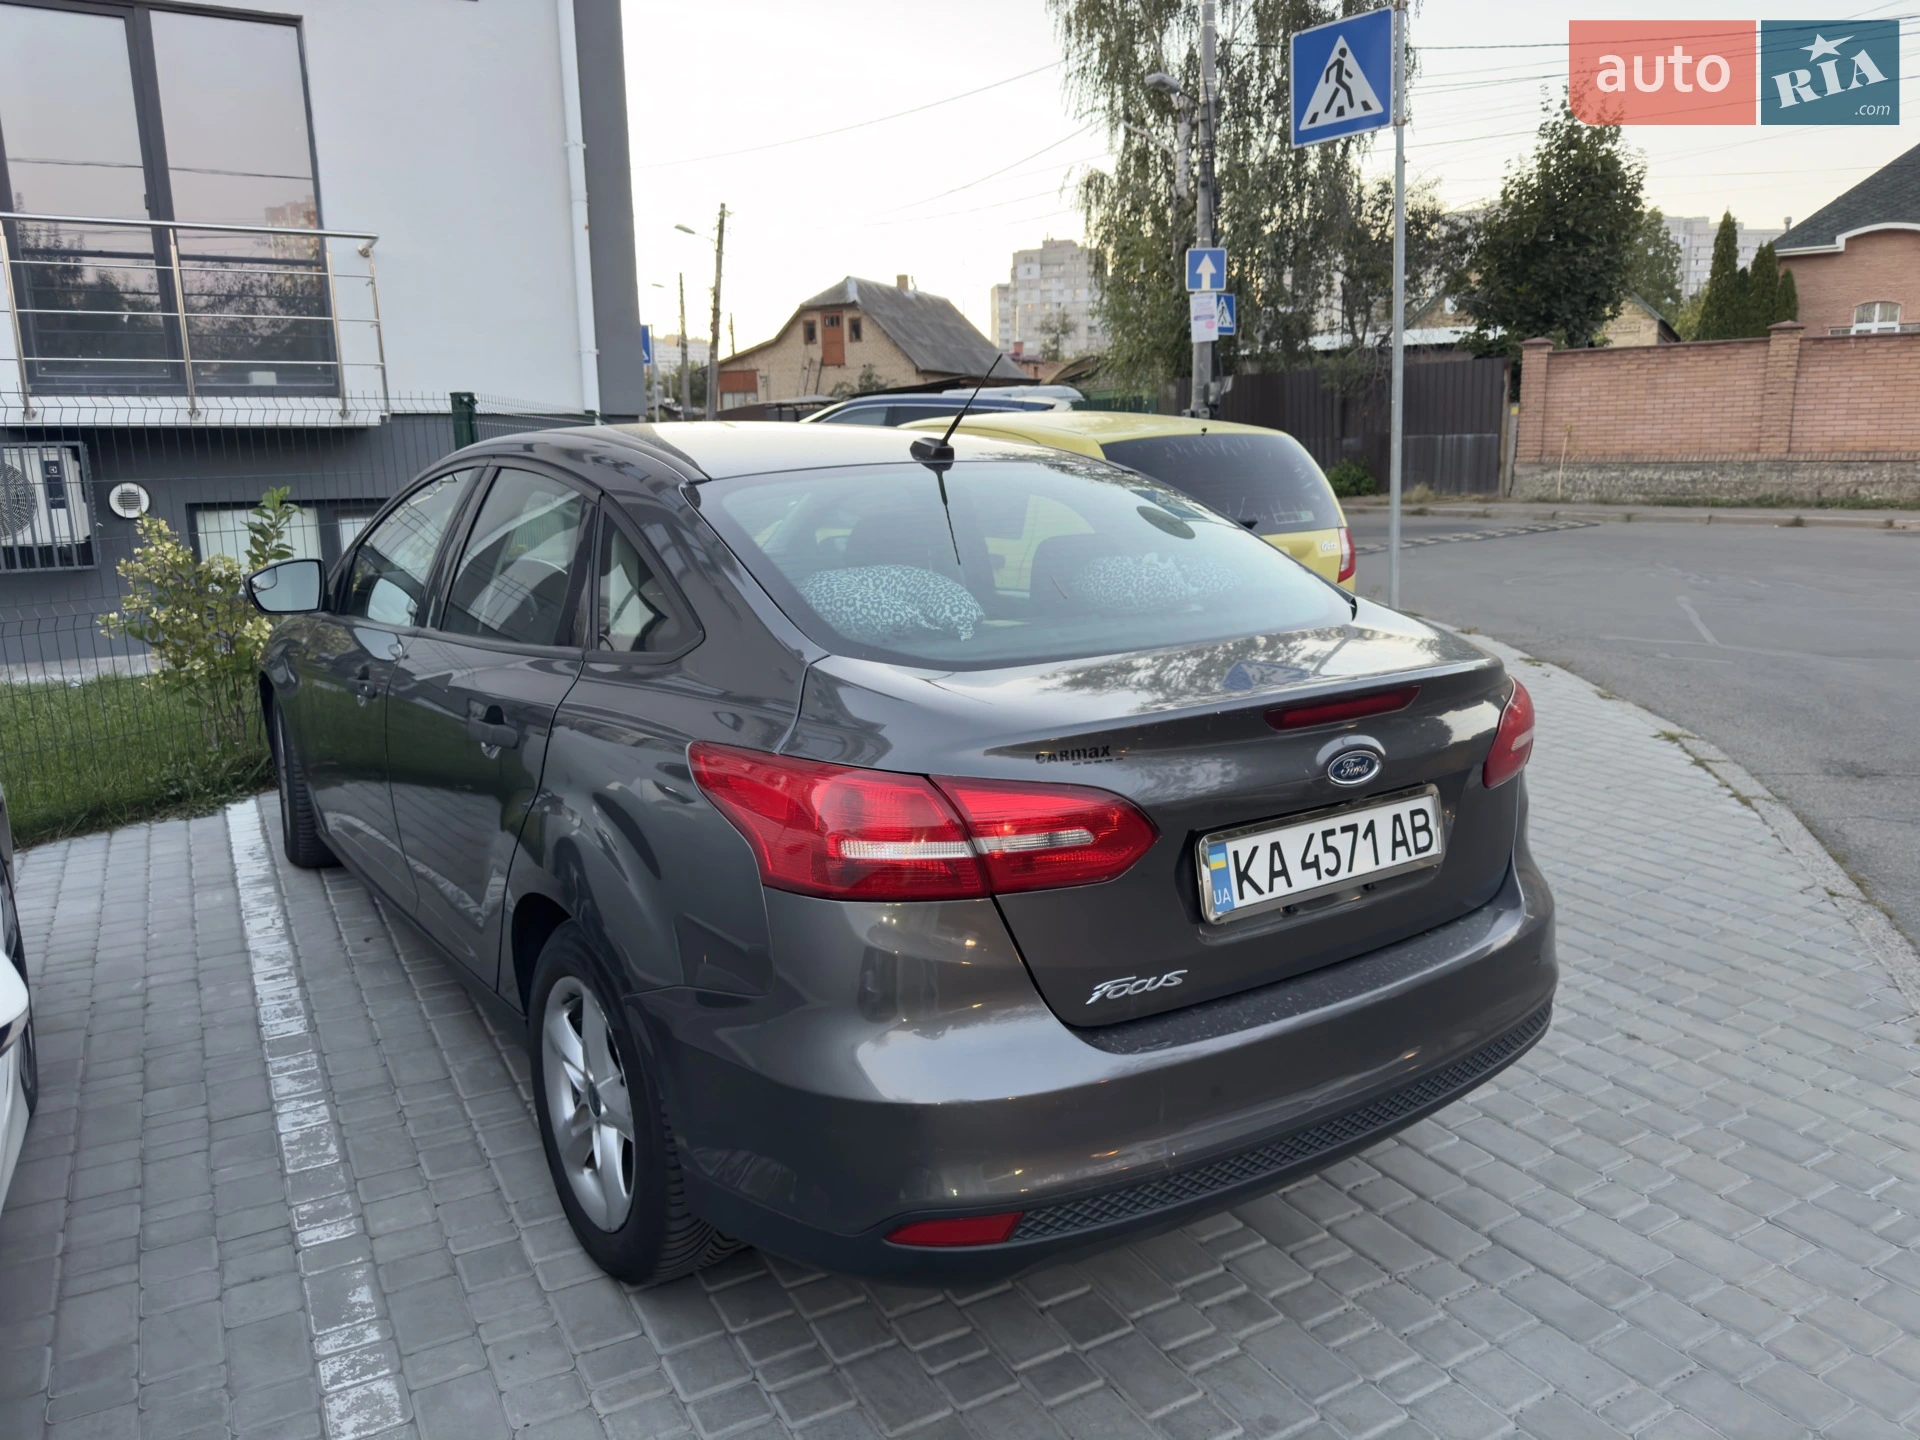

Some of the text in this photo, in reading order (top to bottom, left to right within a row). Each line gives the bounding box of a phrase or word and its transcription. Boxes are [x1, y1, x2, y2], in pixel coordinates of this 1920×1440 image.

[1340, 757, 1369, 777] Ford
[1232, 808, 1434, 901] KA 4571 AB
[1213, 887, 1232, 906] UA
[1085, 969, 1188, 1005] Focus
